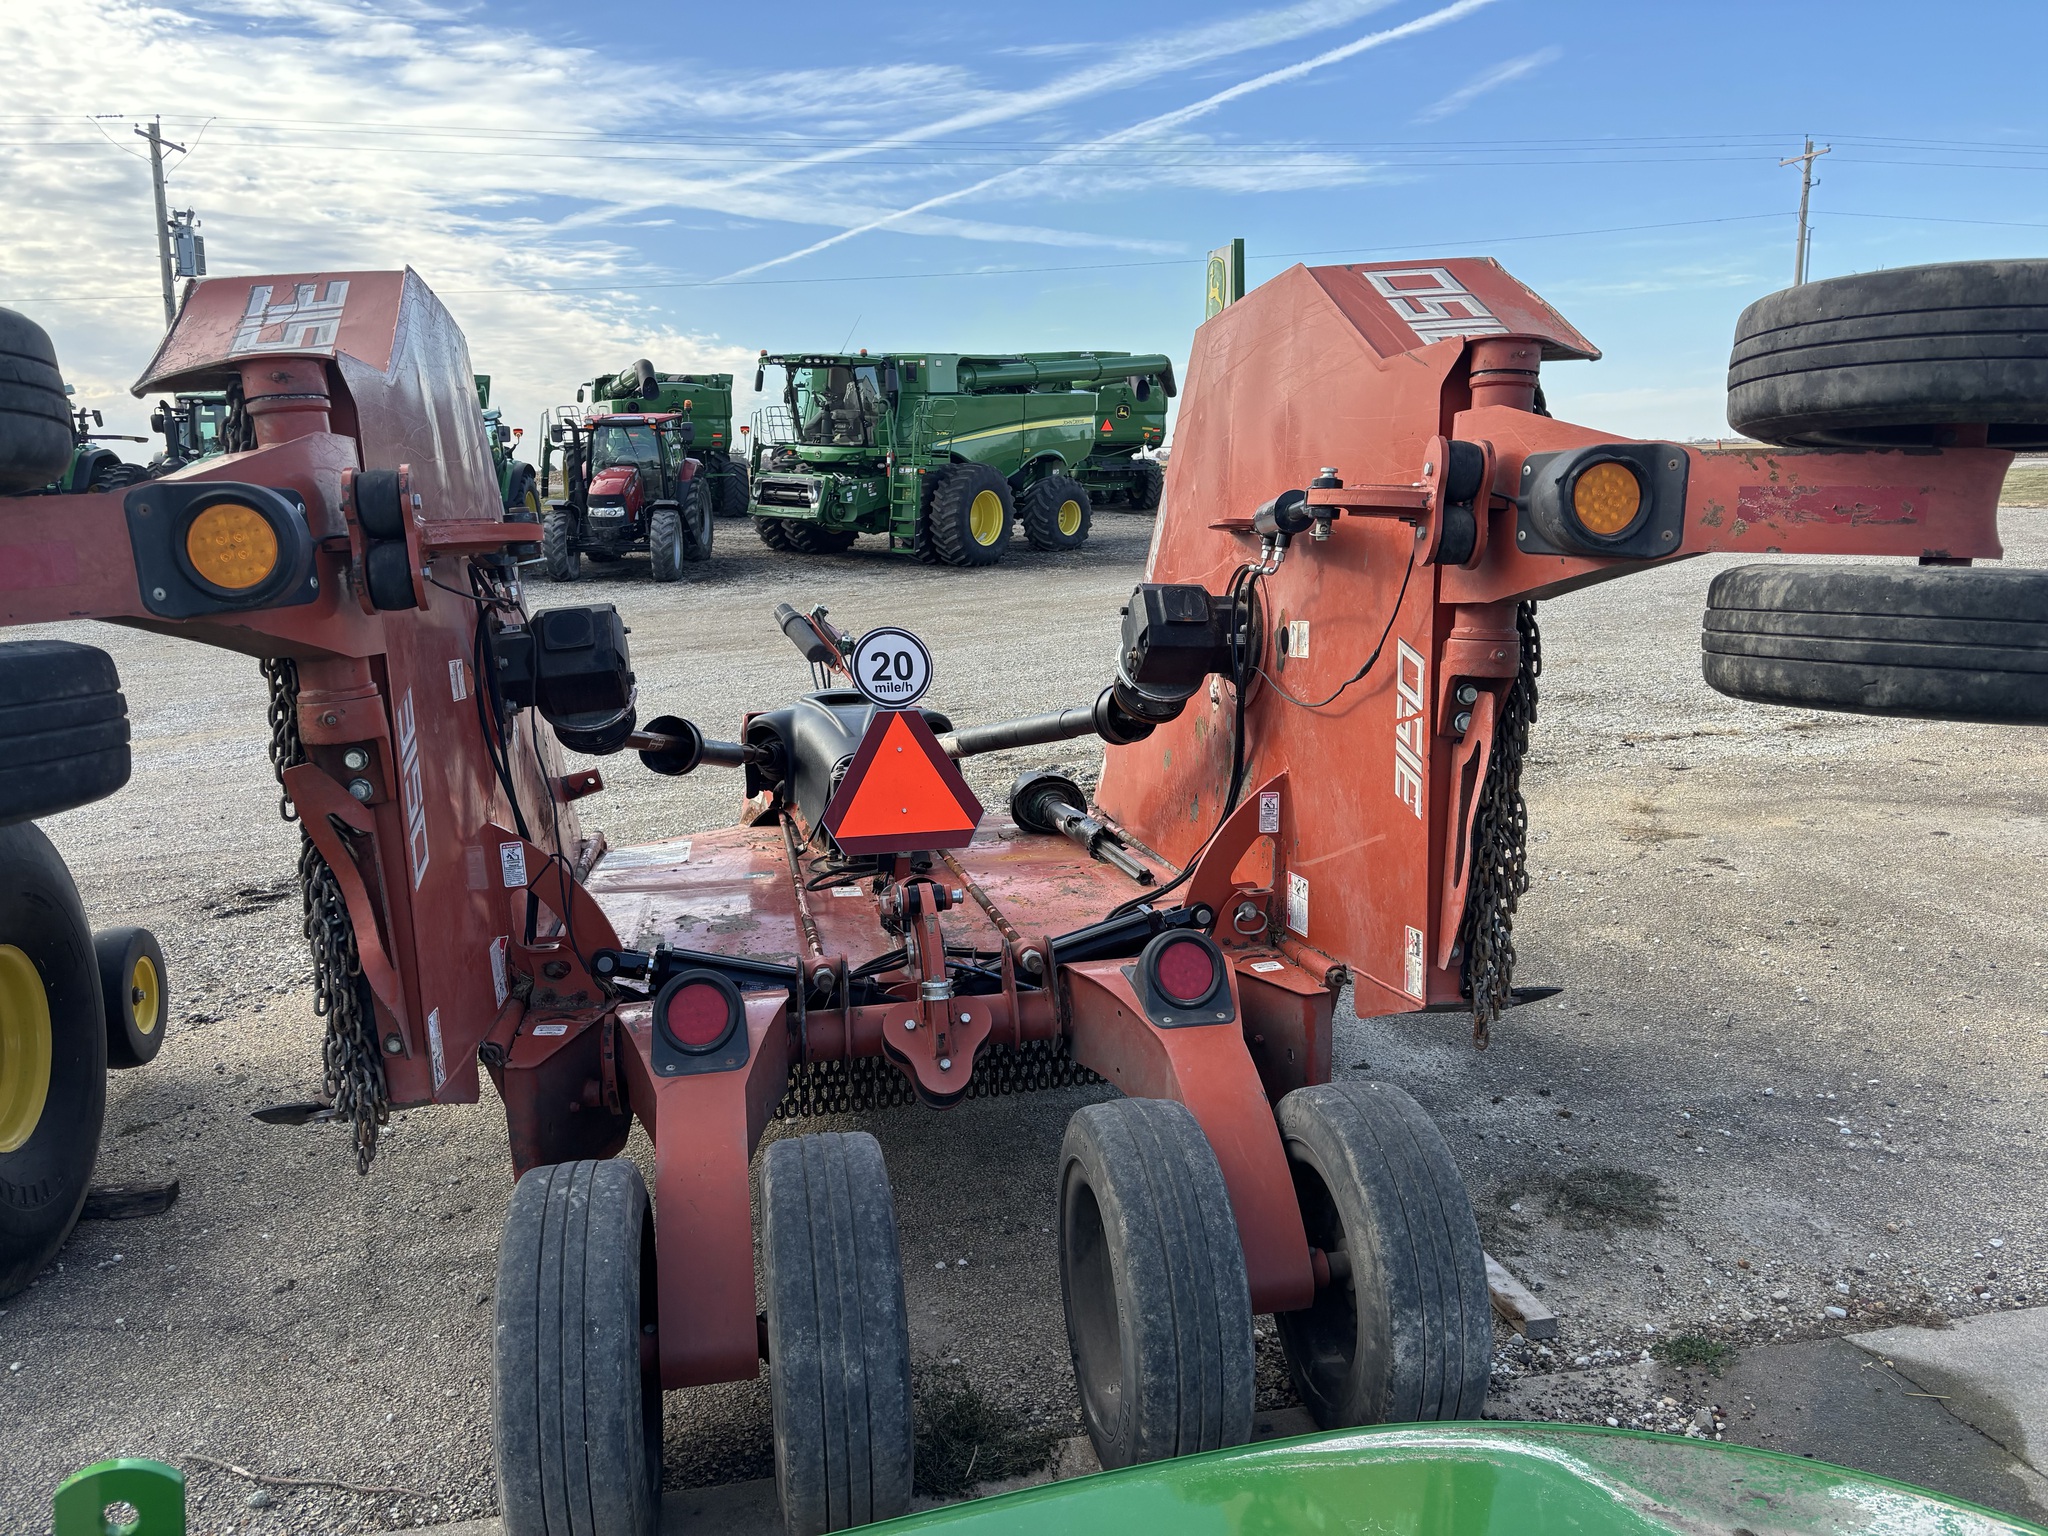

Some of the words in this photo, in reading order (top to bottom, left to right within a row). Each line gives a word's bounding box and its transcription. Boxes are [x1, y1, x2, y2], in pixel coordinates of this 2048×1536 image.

[229, 280, 350, 355] 315
[871, 651, 914, 681] 20
[875, 681, 913, 693] mile/h
